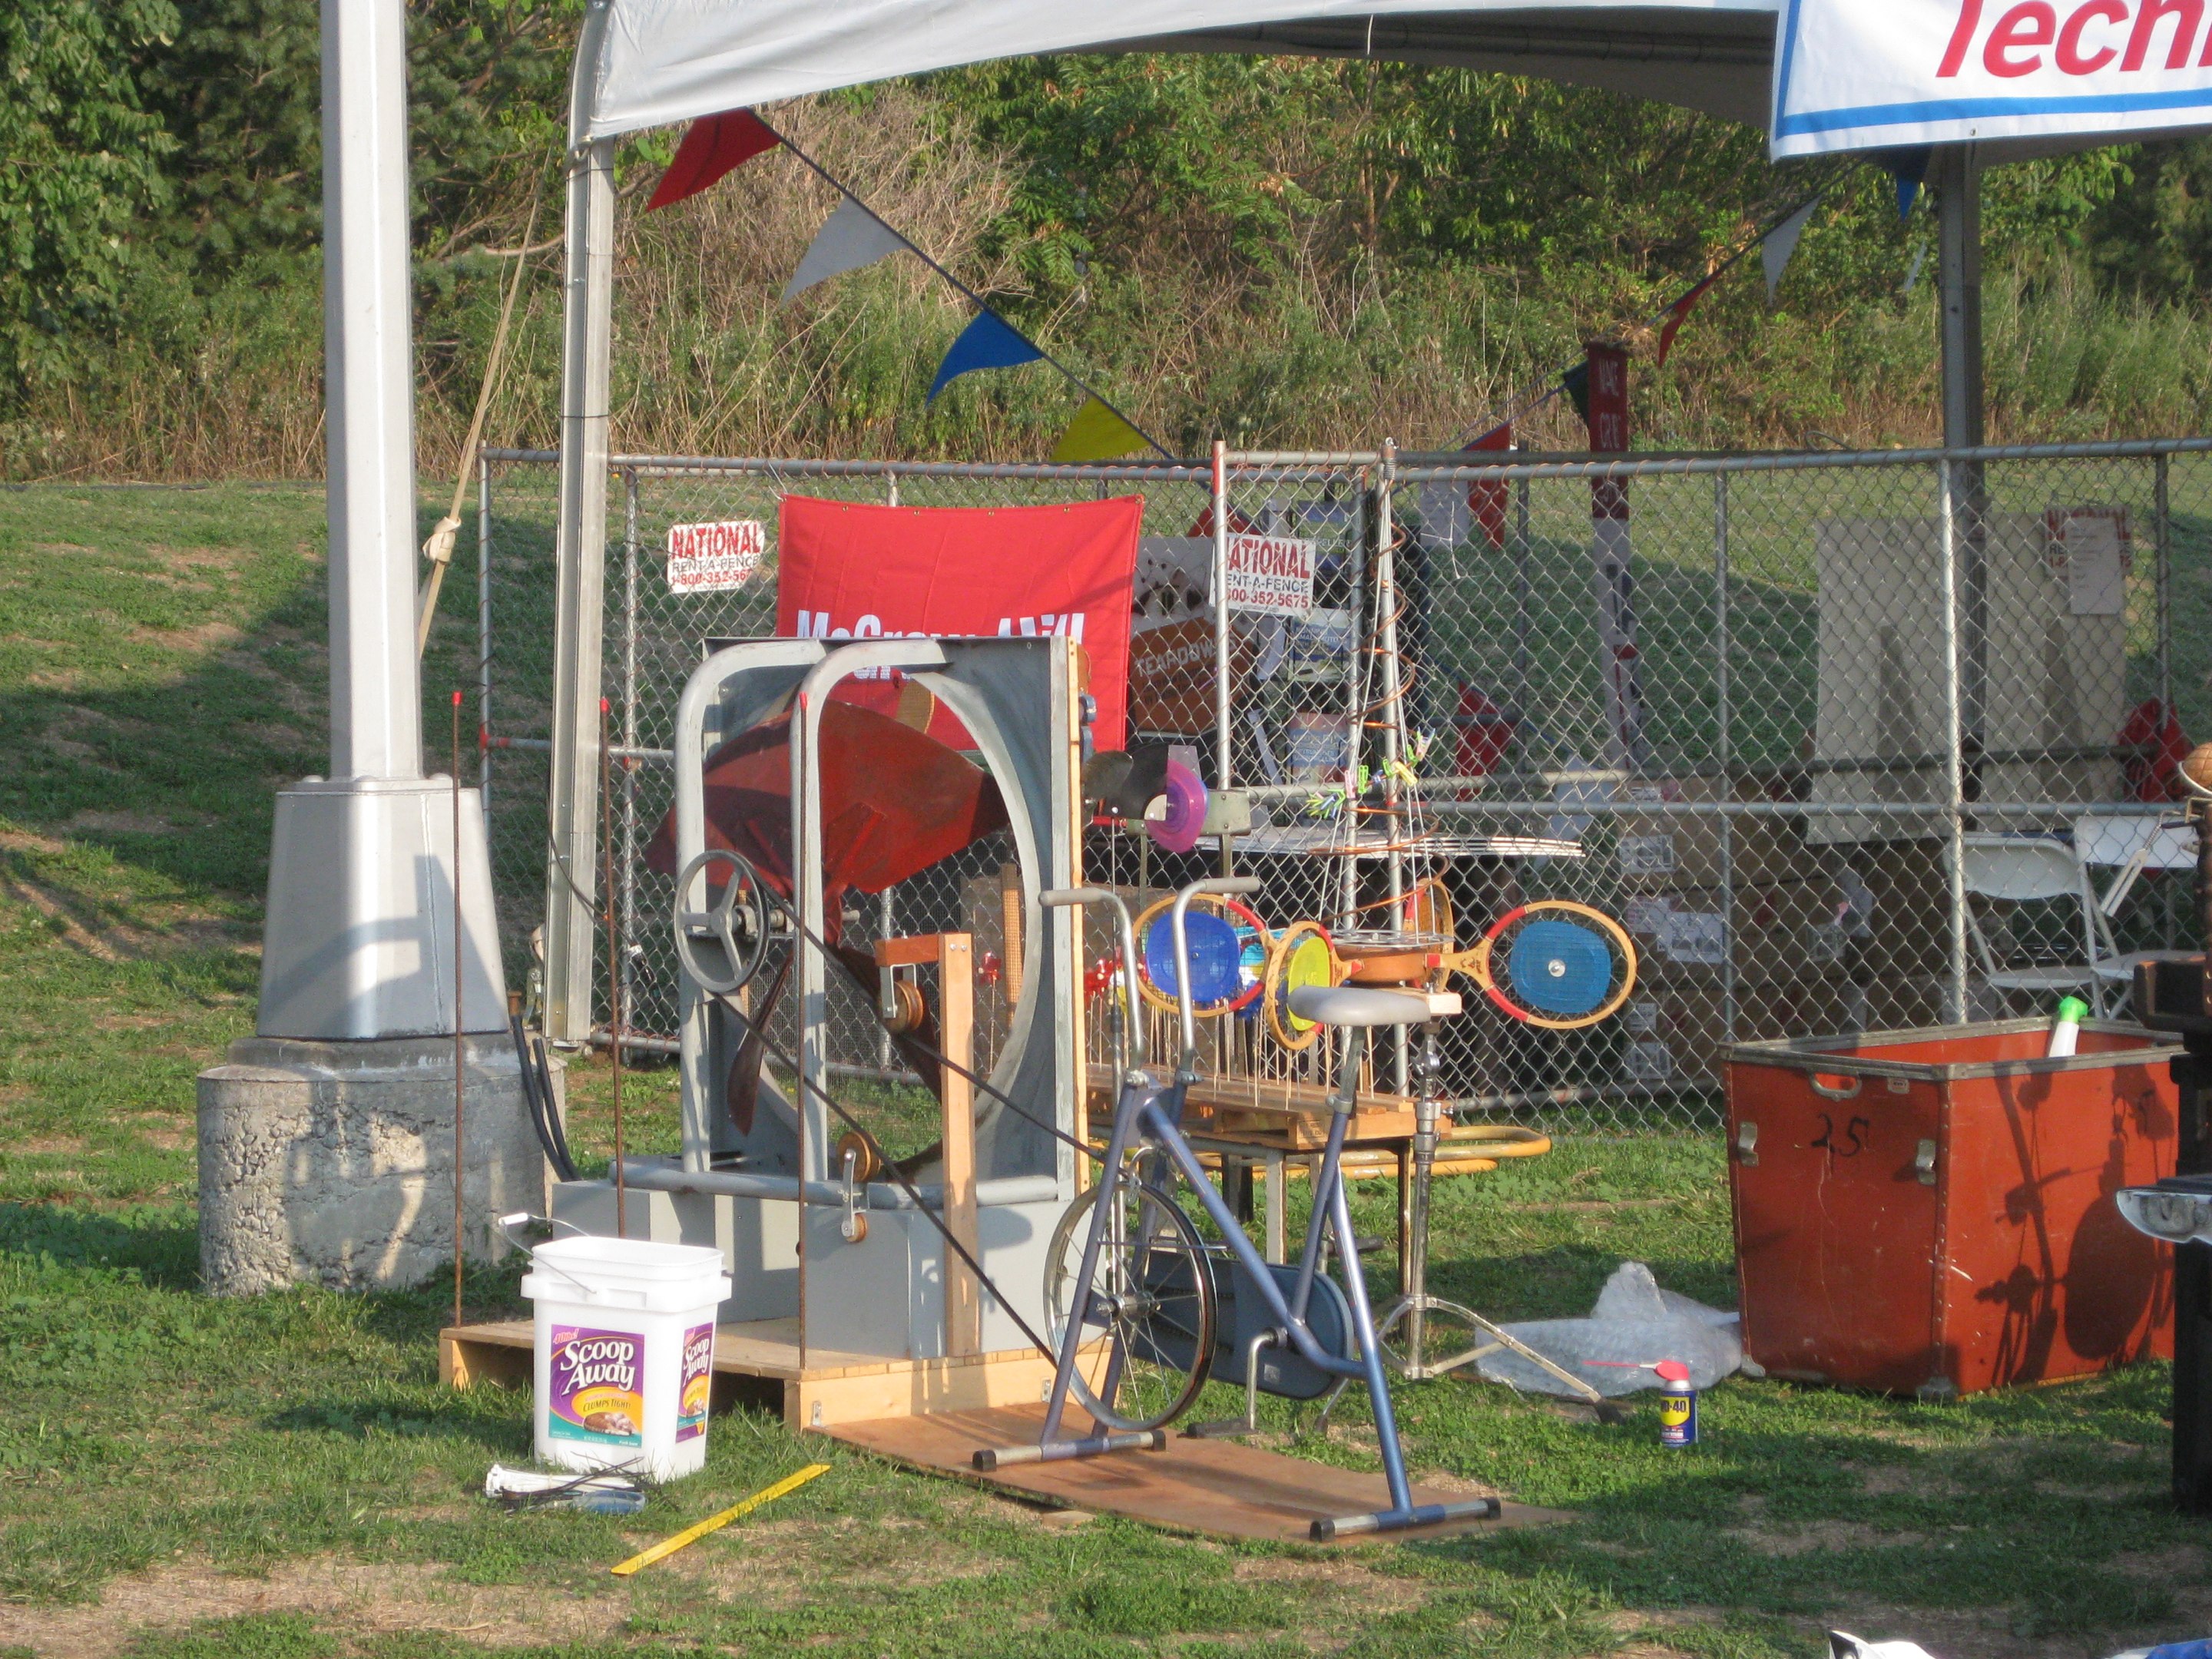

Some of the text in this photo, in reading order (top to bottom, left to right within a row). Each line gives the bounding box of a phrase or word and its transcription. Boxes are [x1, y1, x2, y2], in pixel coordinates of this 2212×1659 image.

[1936, 0, 2212, 78] Tech
[671, 524, 760, 559] NATIONAL
[1227, 538, 1310, 578] ATIONAL
[1227, 573, 1309, 594] ENT-A-FENCE
[1811, 1112, 1869, 1157] 25
[560, 1340, 634, 1371] Scoop
[682, 1353, 709, 1388] Away
[684, 1338, 710, 1369] Scoop
[561, 1363, 636, 1396] Away
